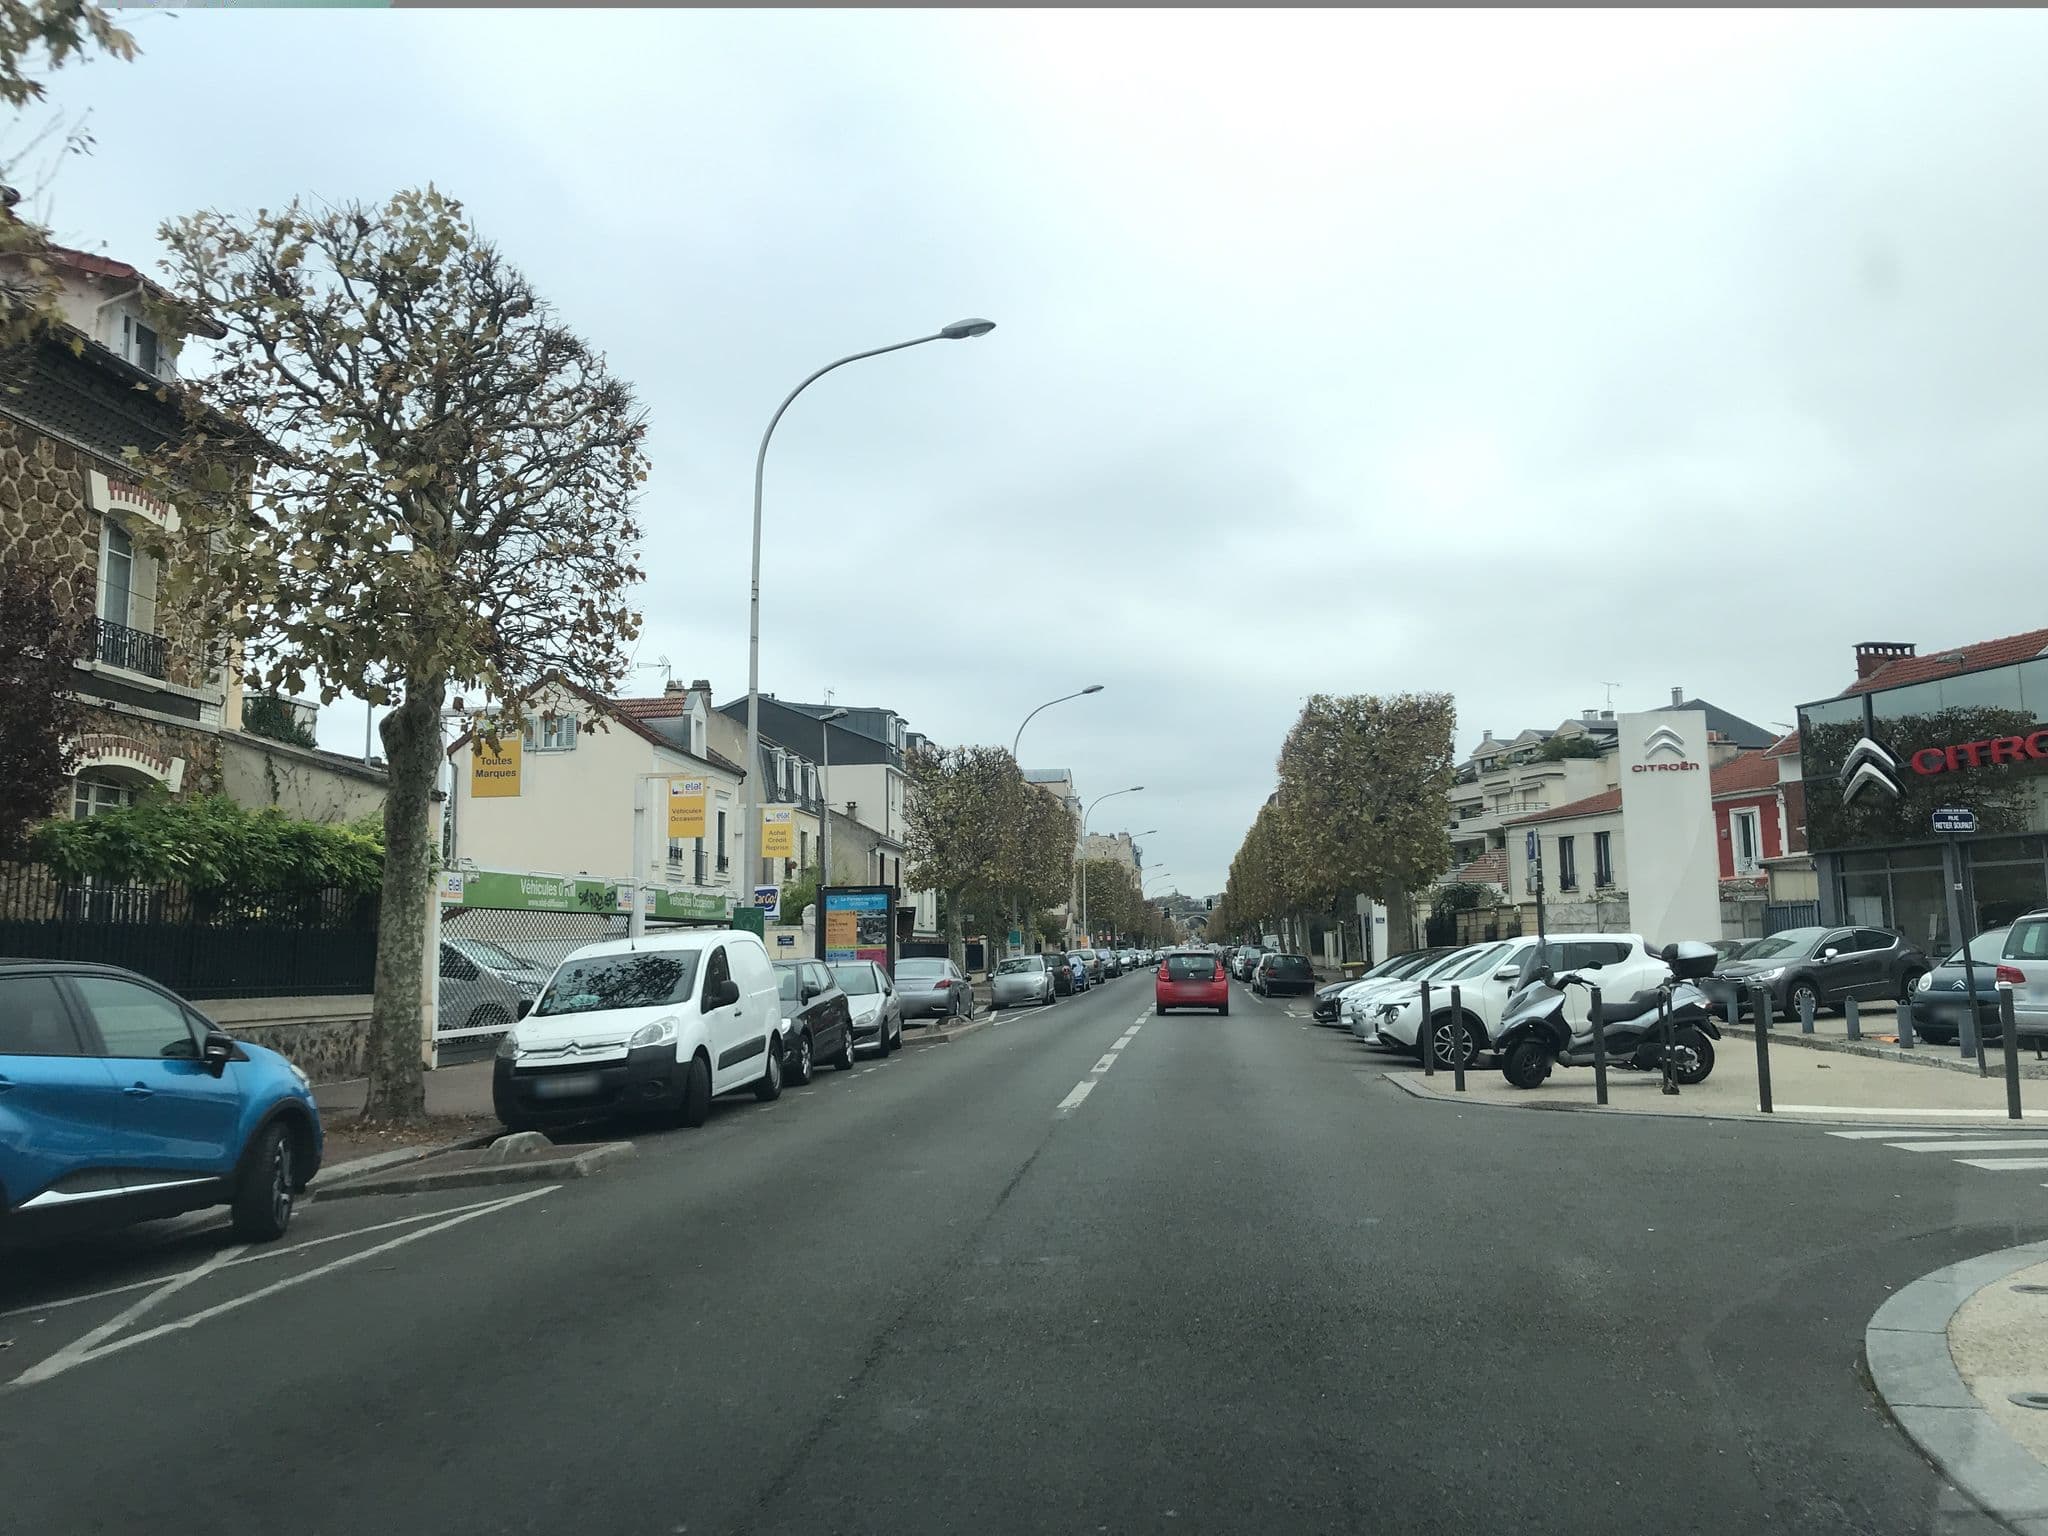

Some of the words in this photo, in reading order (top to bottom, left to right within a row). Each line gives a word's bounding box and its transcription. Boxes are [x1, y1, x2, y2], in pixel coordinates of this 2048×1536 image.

[480, 757, 512, 765] Toutes
[475, 769, 517, 779] Marques
[520, 879, 558, 896] Véhicules
